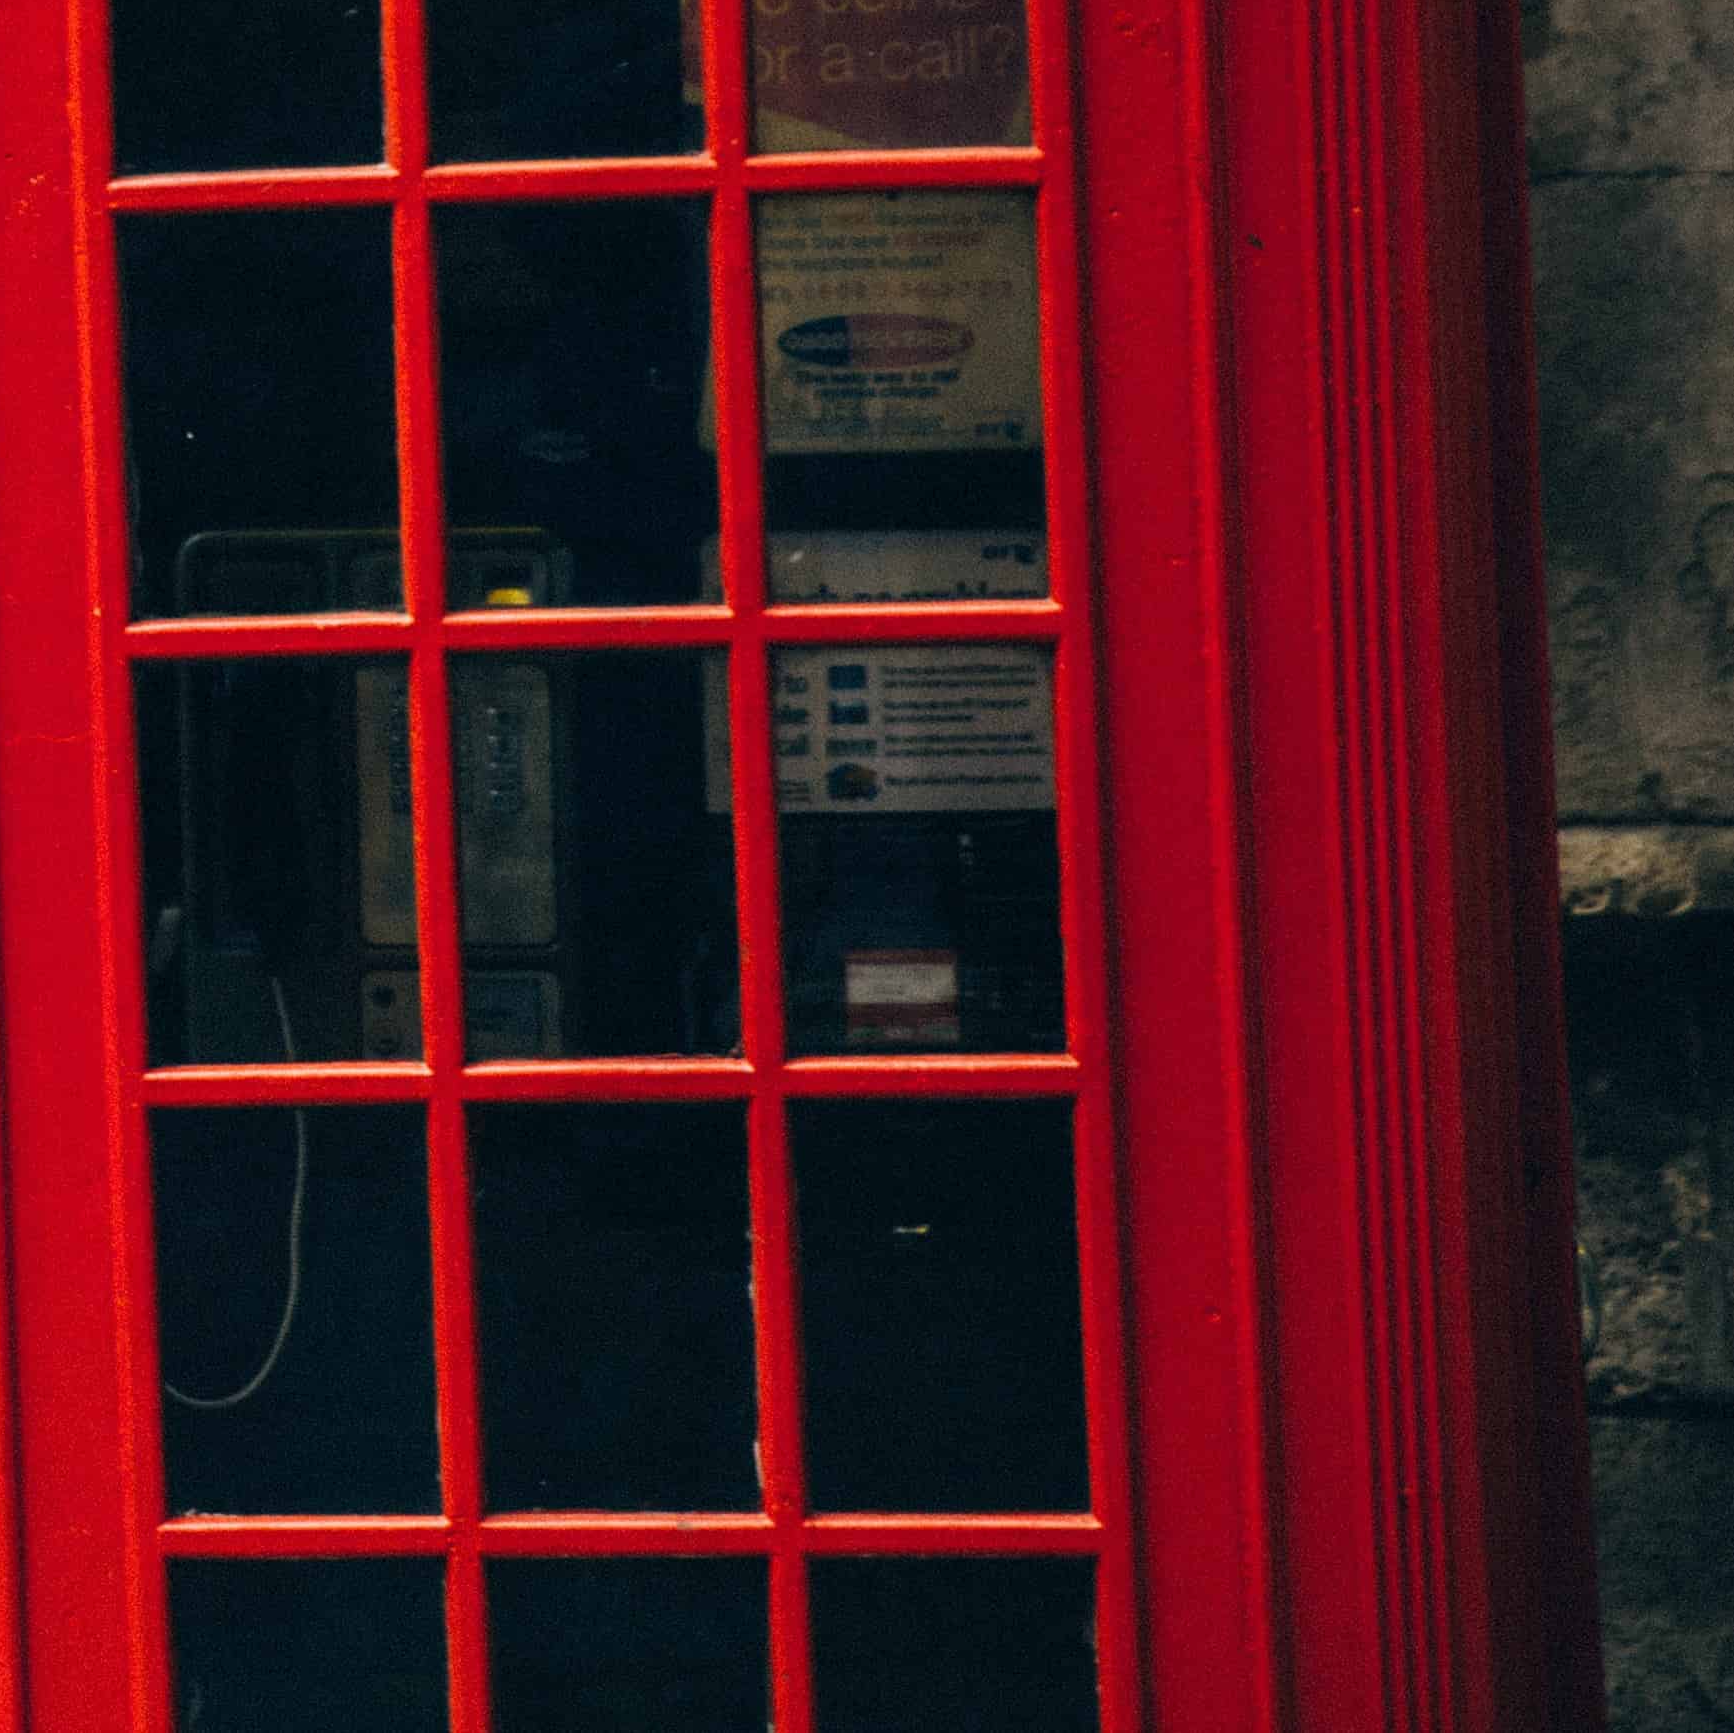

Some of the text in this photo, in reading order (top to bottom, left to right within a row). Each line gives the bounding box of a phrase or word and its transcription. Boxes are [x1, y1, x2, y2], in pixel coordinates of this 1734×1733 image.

[754, 22, 1016, 84] or a call?
